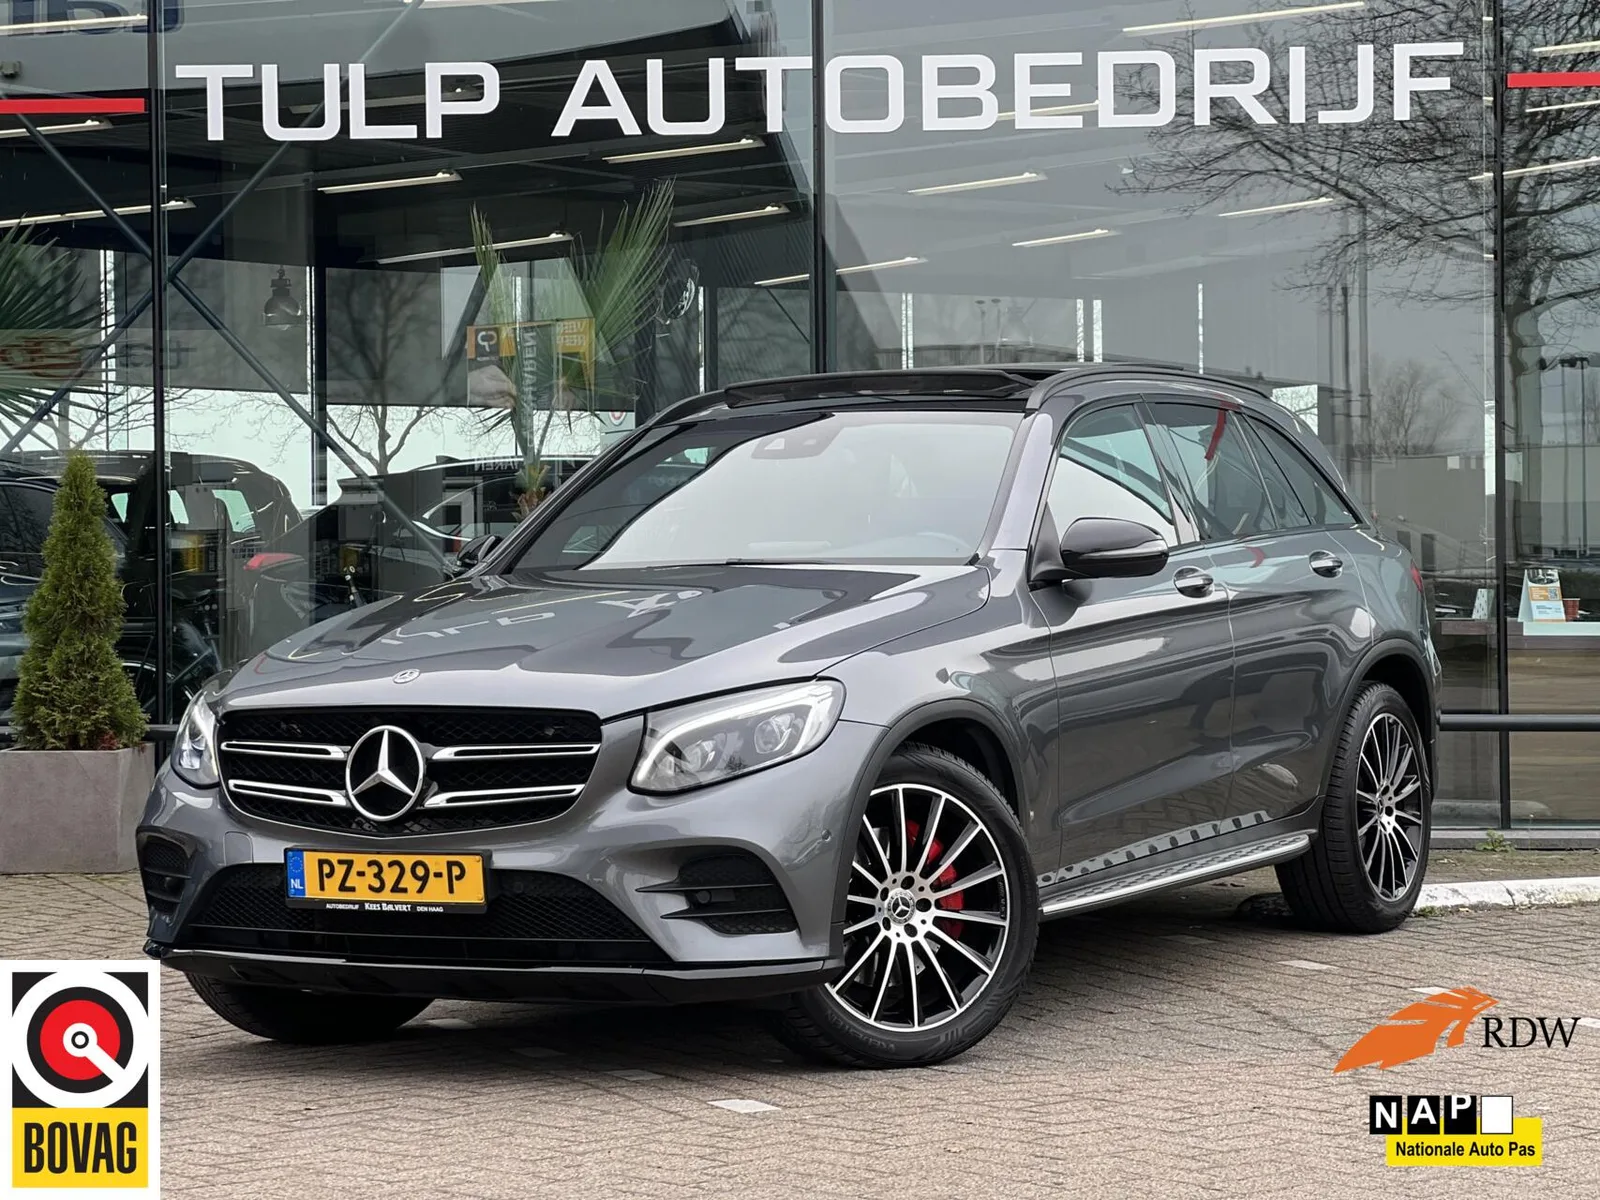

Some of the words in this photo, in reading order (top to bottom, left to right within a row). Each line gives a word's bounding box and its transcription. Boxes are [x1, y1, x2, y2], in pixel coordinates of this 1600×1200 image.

[175, 61, 501, 141] TULP
[550, 41, 1464, 137] AUTOBEDRIJF
[290, 879, 303, 889] NL
[317, 858, 467, 894] PZ-329-P
